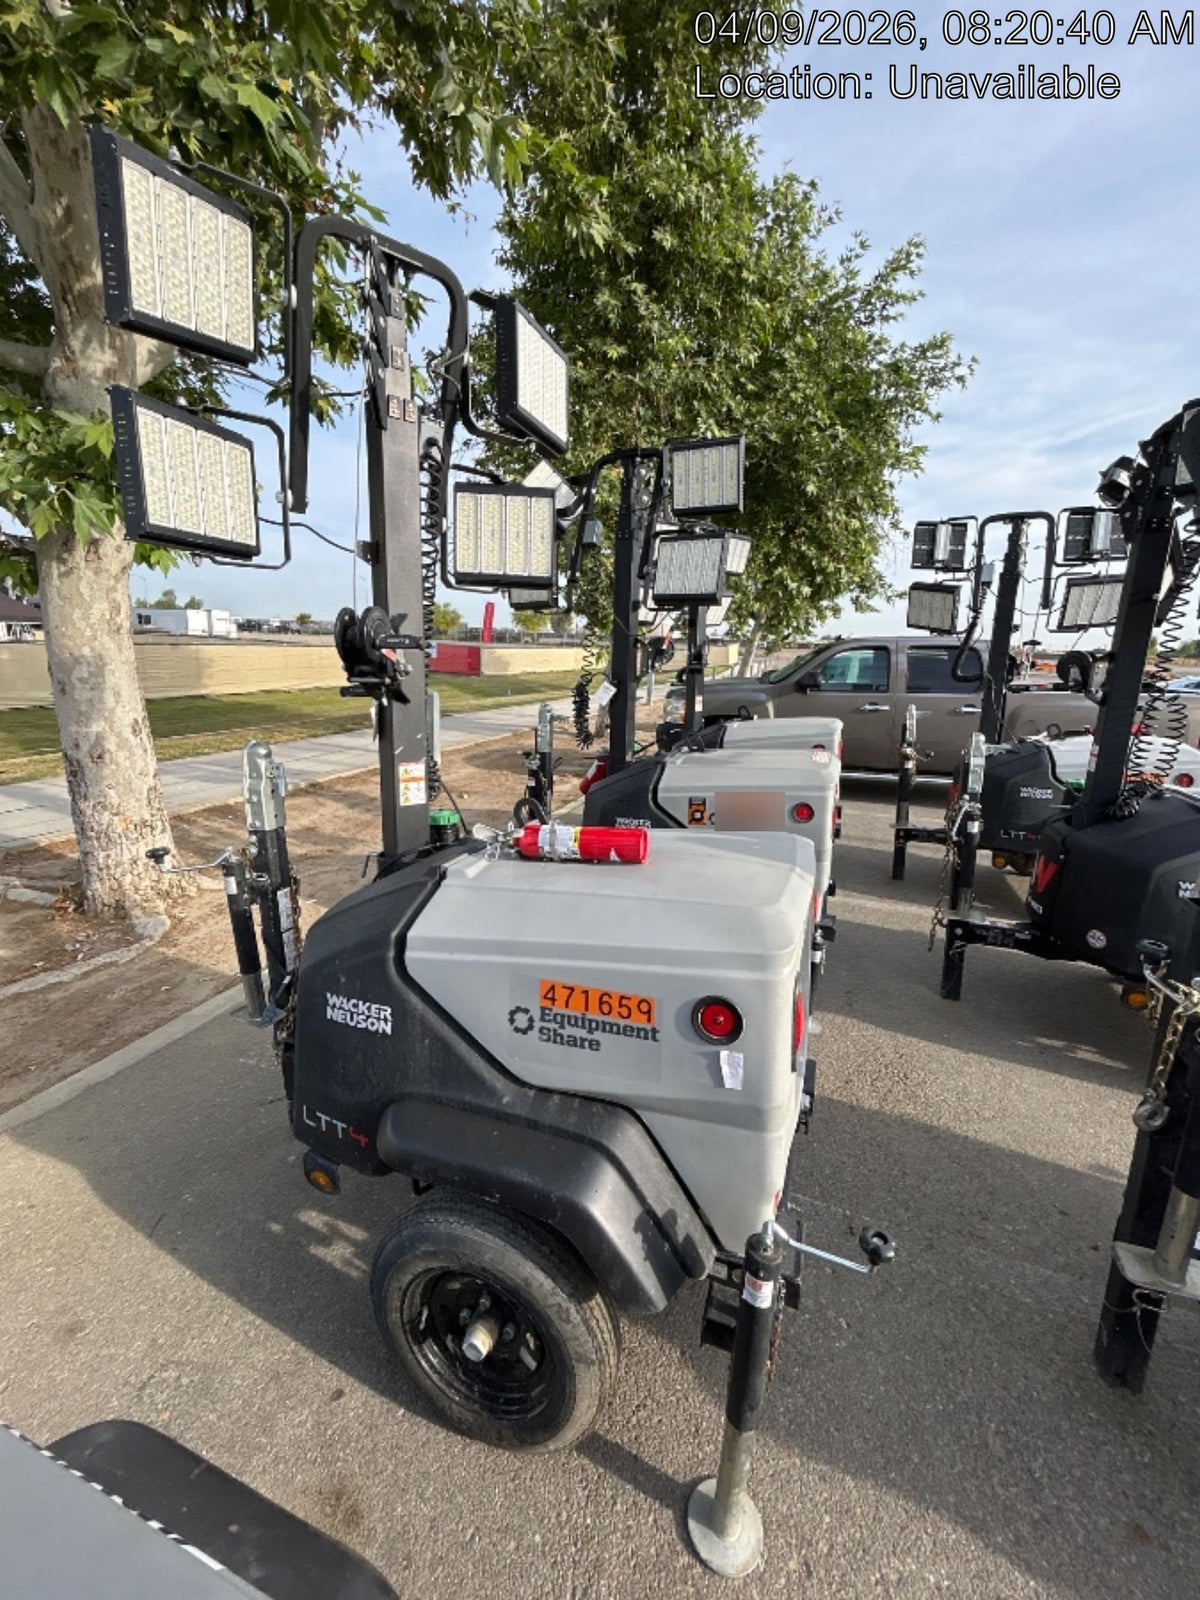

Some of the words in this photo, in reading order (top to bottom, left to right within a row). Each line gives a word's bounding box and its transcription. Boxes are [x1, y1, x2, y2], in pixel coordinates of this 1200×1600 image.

[326, 992, 392, 1021] WACKER
[543, 984, 652, 1023] 471659
[326, 1006, 392, 1035] NEUSON
[540, 1006, 660, 1042] Equipment
[538, 1026, 601, 1051] Share
[302, 1104, 369, 1148] LTT4
